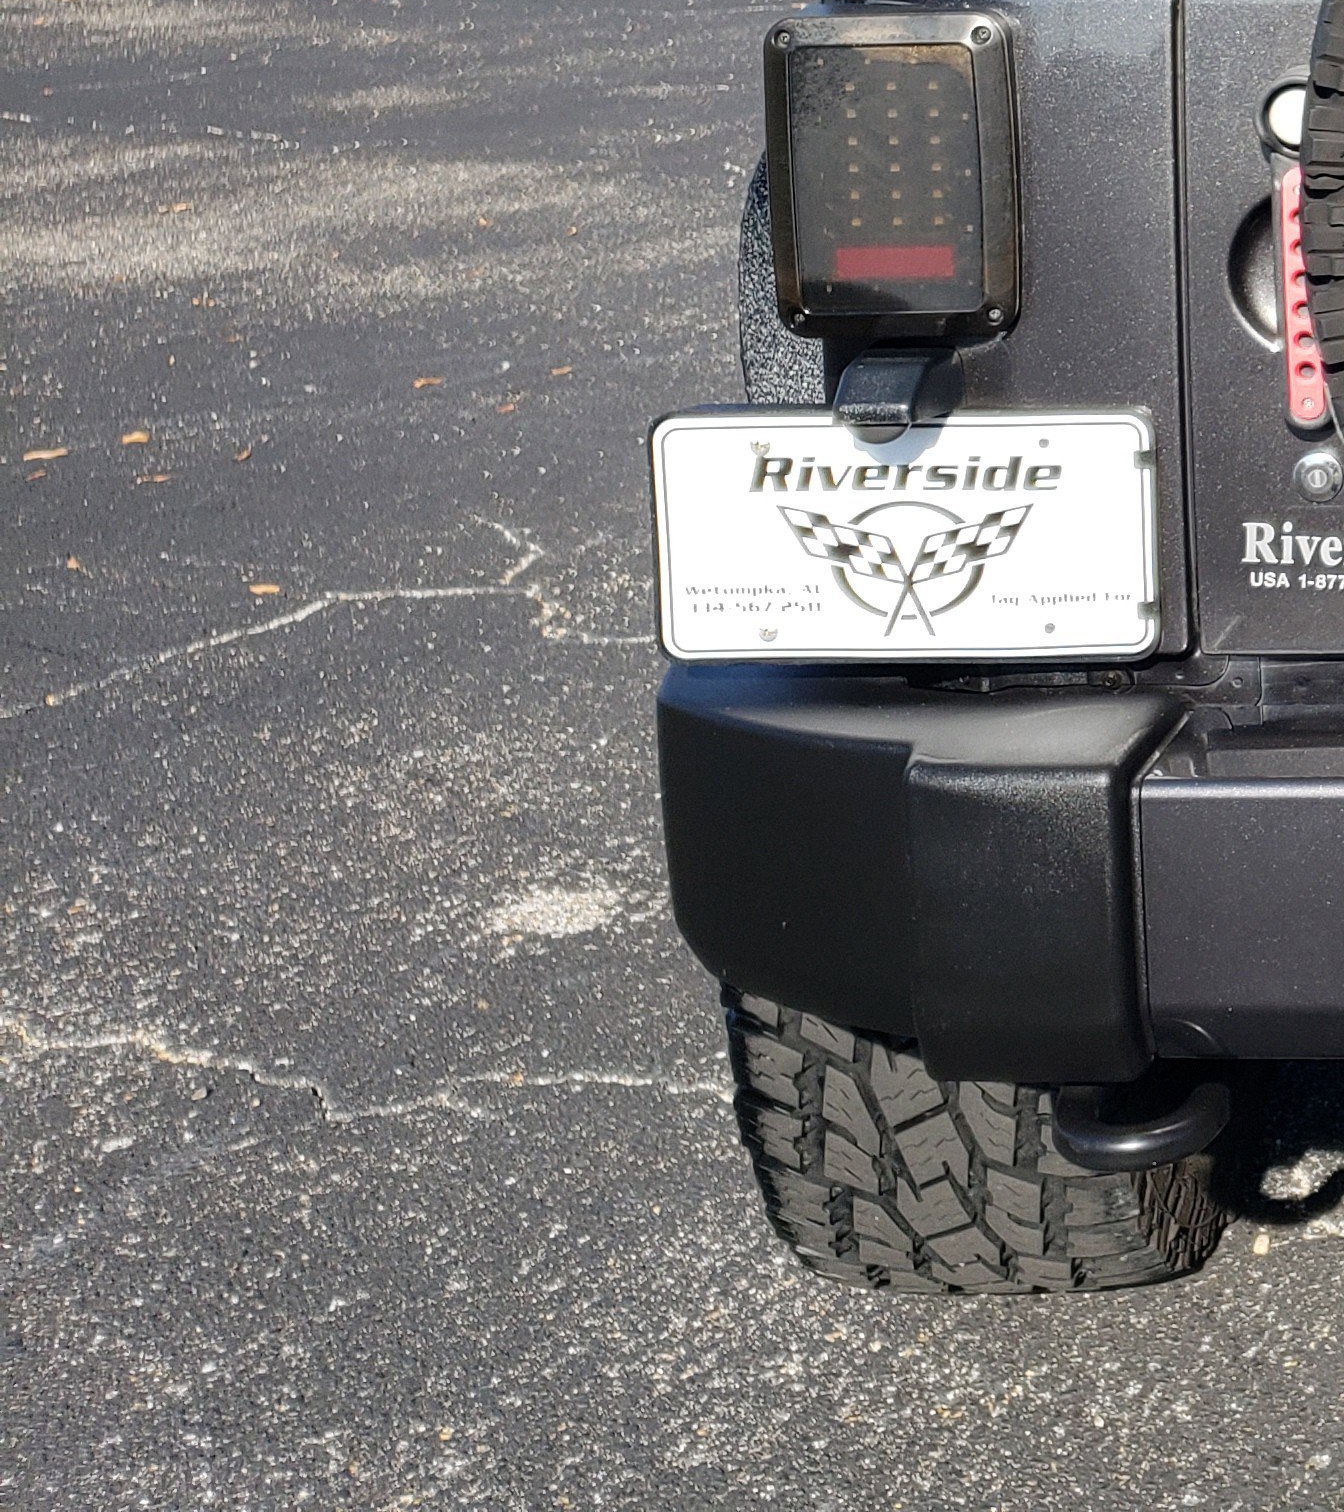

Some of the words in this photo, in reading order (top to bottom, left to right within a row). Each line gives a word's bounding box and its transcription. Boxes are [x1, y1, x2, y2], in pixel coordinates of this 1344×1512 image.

[749, 455, 1062, 493] Riverside
[1250, 571, 1290, 589] USA
[1029, 592, 1096, 606] Applied
